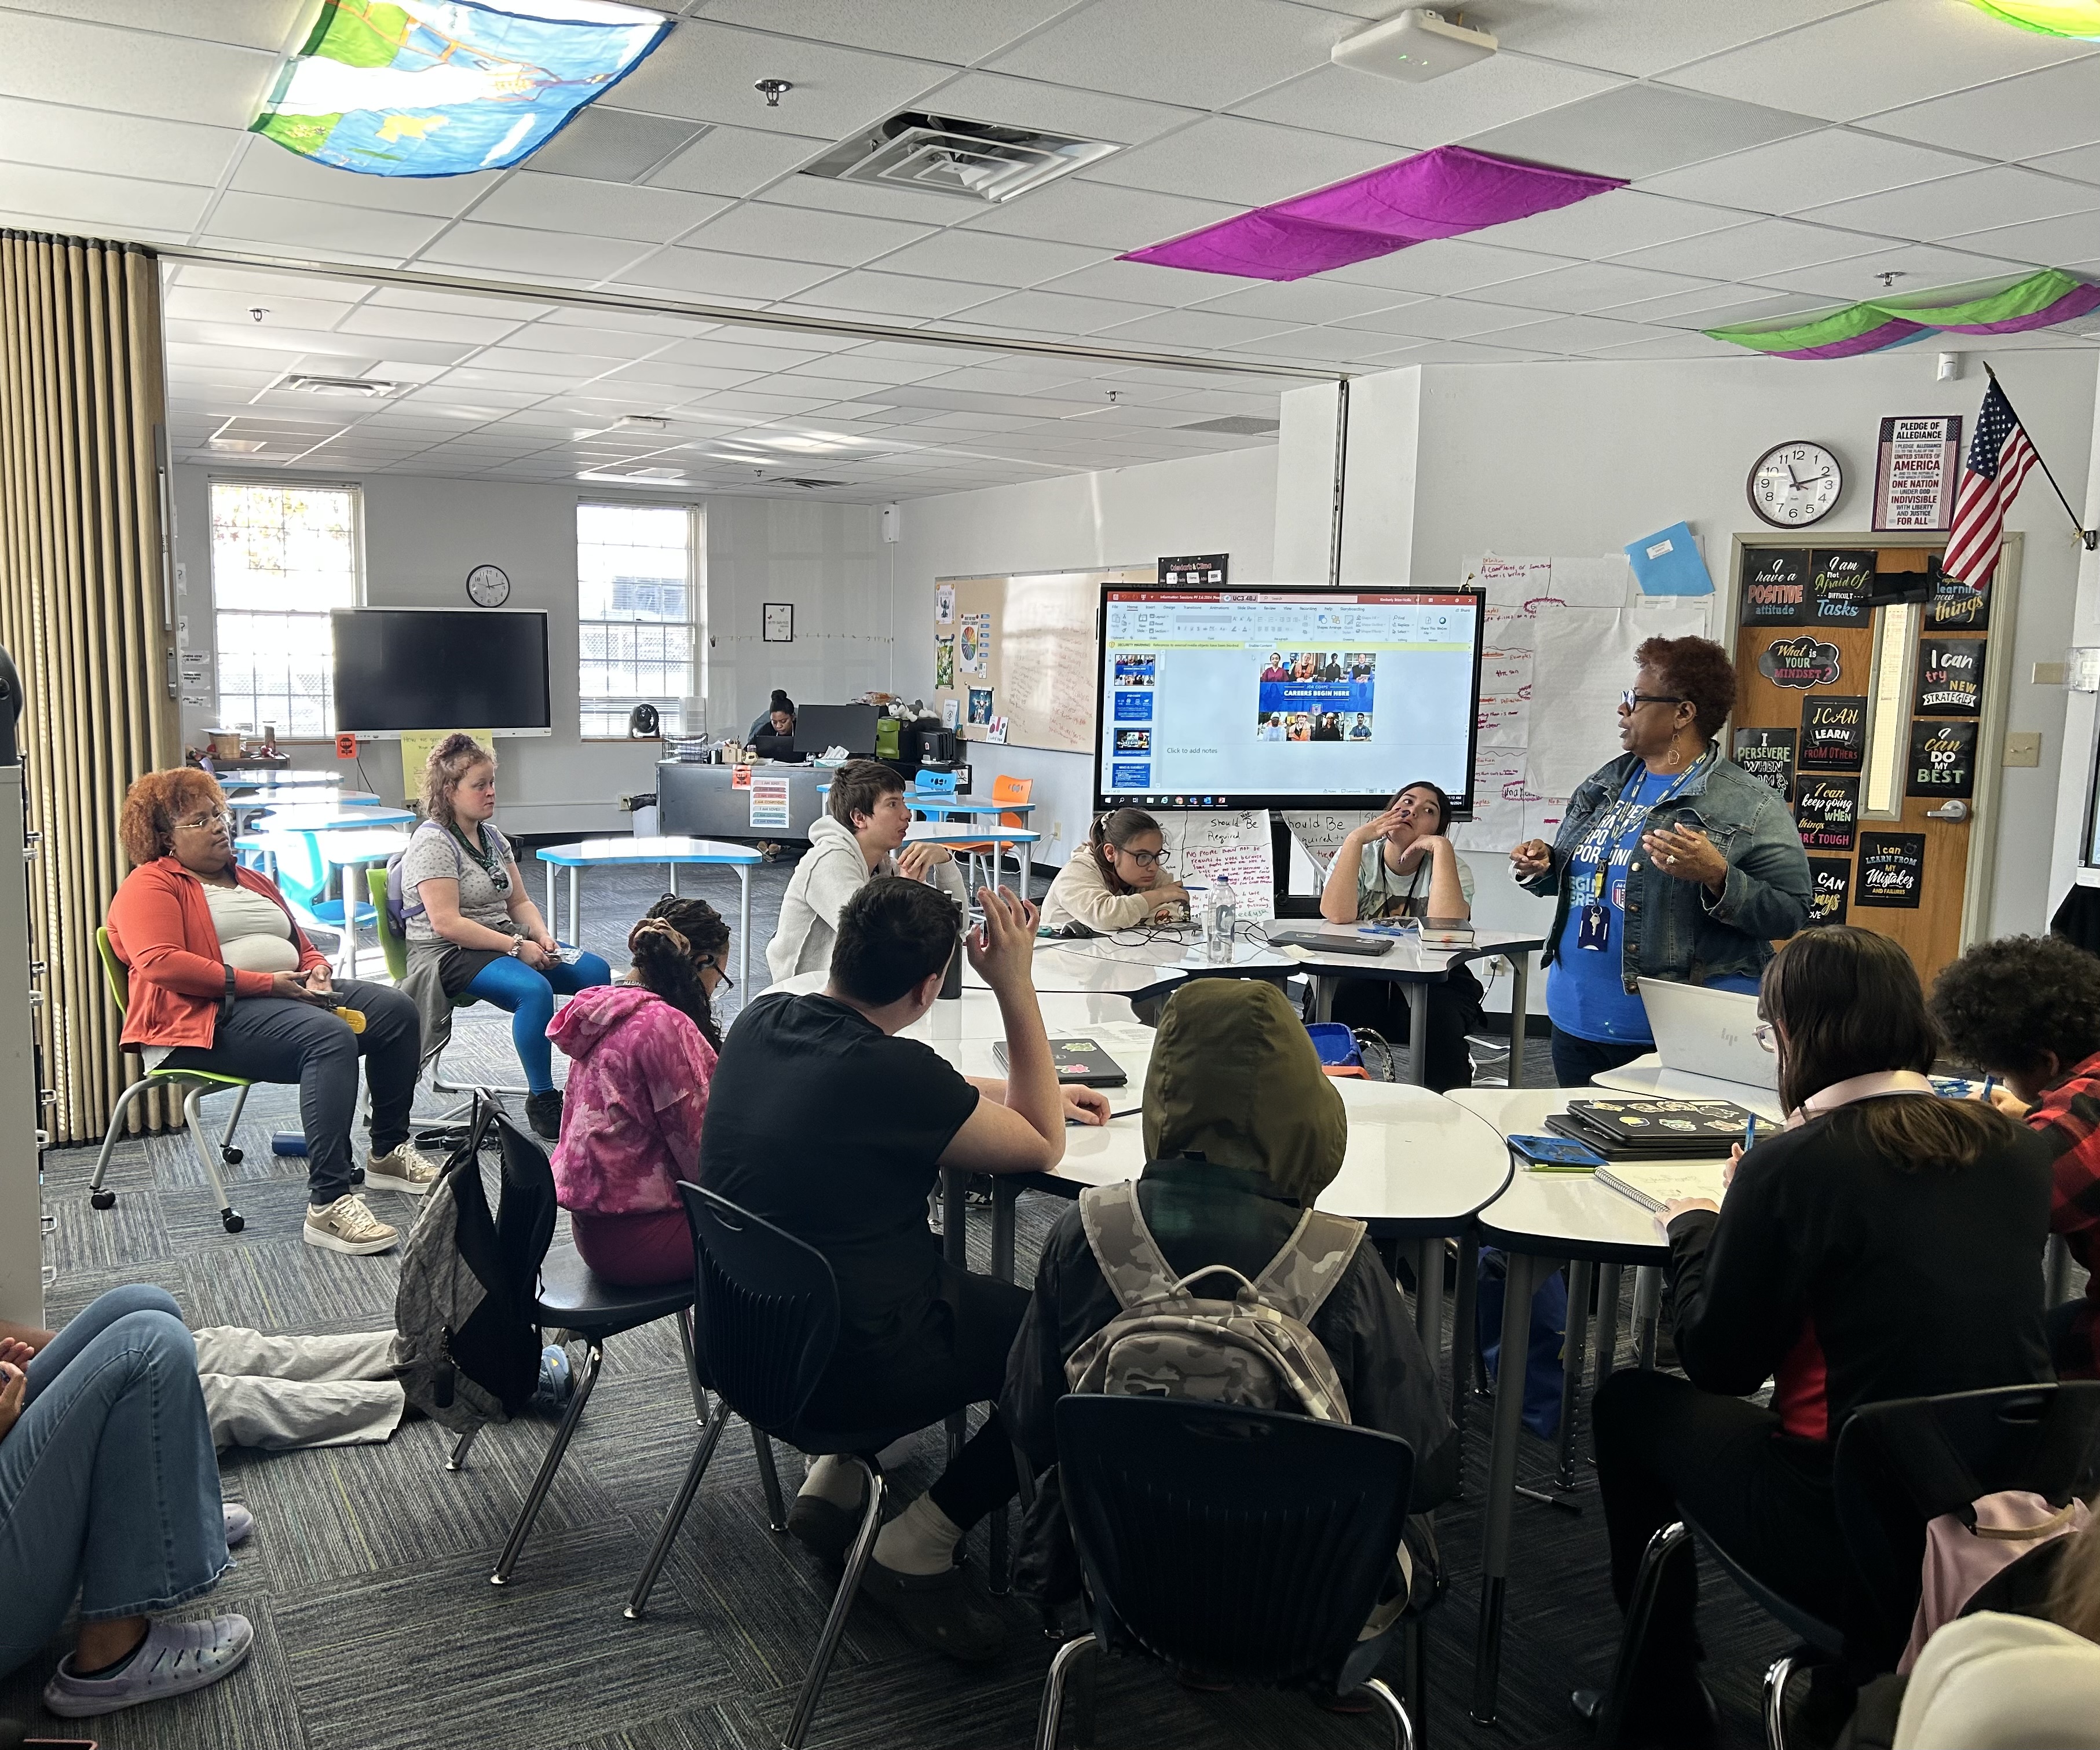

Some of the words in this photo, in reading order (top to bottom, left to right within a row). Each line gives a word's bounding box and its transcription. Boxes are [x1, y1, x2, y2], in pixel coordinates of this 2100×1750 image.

[1900, 422, 1929, 430] PLEDGE
[1930, 422, 1940, 430] OF
[1896, 431, 1942, 439] ALLEGIANCE
[1779, 455, 1788, 465] 11
[1792, 450, 1805, 461] 12
[1814, 455, 1818, 465] 1
[1821, 466, 1831, 477] 2
[1893, 461, 1940, 471] AMERICA
[1761, 478, 1770, 488] 9
[1824, 480, 1833, 489] 3
[1892, 480, 1908, 488] ONE
[1910, 480, 1939, 488] NATION
[1765, 492, 1774, 502] 8
[1818, 494, 1827, 503] 4
[1891, 495, 1937, 503] INDIVISIBLE
[1776, 503, 1784, 513] 7
[1788, 509, 1798, 518] 6
[1805, 504, 1814, 513] 5
[1897, 517, 1912, 525] FOR
[1772, 559, 1783, 574] I
[1829, 556, 1840, 571] I
[1839, 561, 1860, 571] am
[1755, 571, 1786, 582] have
[1787, 572, 1797, 581] a
[1814, 573, 1849, 594] Afraid
[1747, 584, 1803, 604] POSITIVE
[1755, 605, 1795, 615] attitude
[1816, 599, 1860, 617] Tasks
[1934, 595, 1984, 623] things
[1775, 644, 1808, 657] What
[1809, 649, 1817, 658] is
[1786, 657, 1810, 668] YOUR
[1931, 649, 1937, 668] I
[1941, 653, 1974, 670] can
[1925, 670, 1948, 684] try
[1949, 680, 1977, 694] NEW
[1926, 693, 1973, 704] STRATEGIES
[1813, 708, 1821, 724] I
[1823, 707, 1858, 725] CAN
[1761, 732, 1768, 747] I
[1814, 729, 1850, 740] LEARN
[1938, 728, 1952, 740] I
[1924, 738, 1964, 751] can
[1737, 747, 1791, 762] PERSEVERE
[1803, 747, 1828, 759] FROM
[1829, 747, 1858, 759] OTHERS
[1930, 751, 1956, 763] DO
[1743, 761, 1783, 772] WHEN
[1934, 762, 1948, 770] MY
[1917, 769, 1964, 784] BEST
[1814, 782, 1827, 797] I
[1824, 788, 1845, 798] can
[1801, 793, 1825, 811] keep
[1824, 798, 1853, 812] going
[1246, 818, 1259, 830] Be
[1287, 814, 1320, 830] hould
[1326, 817, 1345, 831] Be
[1798, 817, 1825, 834] things
[1207, 831, 1241, 844] Required
[1301, 833, 1333, 845] quired
[1819, 834, 1849, 846] TOUGH
[1572, 845, 1632, 865] PORUNI
[1876, 844, 1881, 855] I
[1883, 847, 1901, 855] can
[1865, 855, 1892, 864] LEARN
[1893, 854, 1918, 866] FROM
[1569, 876, 1596, 892] EGI
[1817, 872, 1846, 890] CAN
[1865, 869, 1914, 889] Mistakes
[1570, 891, 1594, 905] ERE
[1814, 893, 1841, 916] ays
